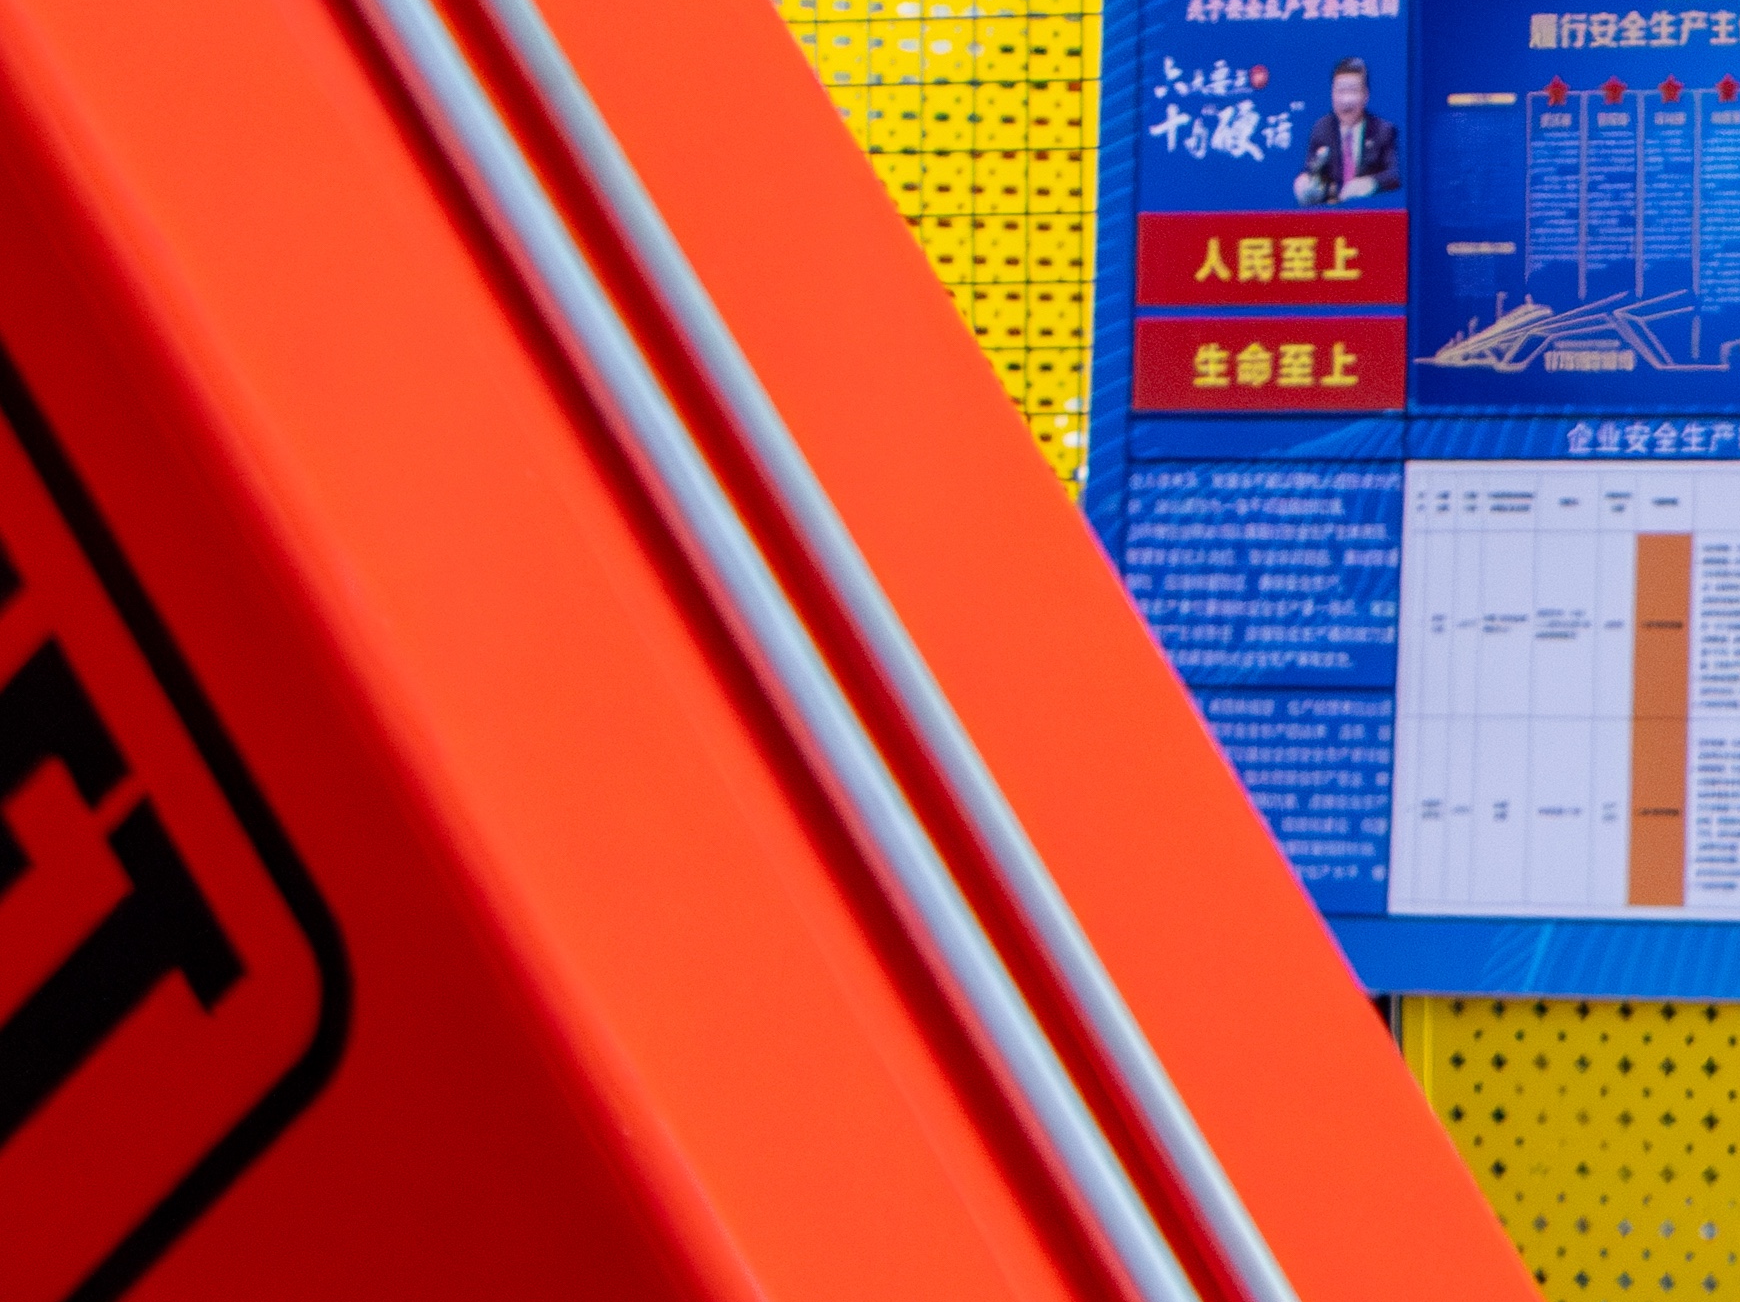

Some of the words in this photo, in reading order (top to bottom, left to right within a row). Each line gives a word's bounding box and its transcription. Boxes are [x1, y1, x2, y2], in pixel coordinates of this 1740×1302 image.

[1193, 235, 1362, 283] 人民至上
[1192, 341, 1360, 389] 生命至上
